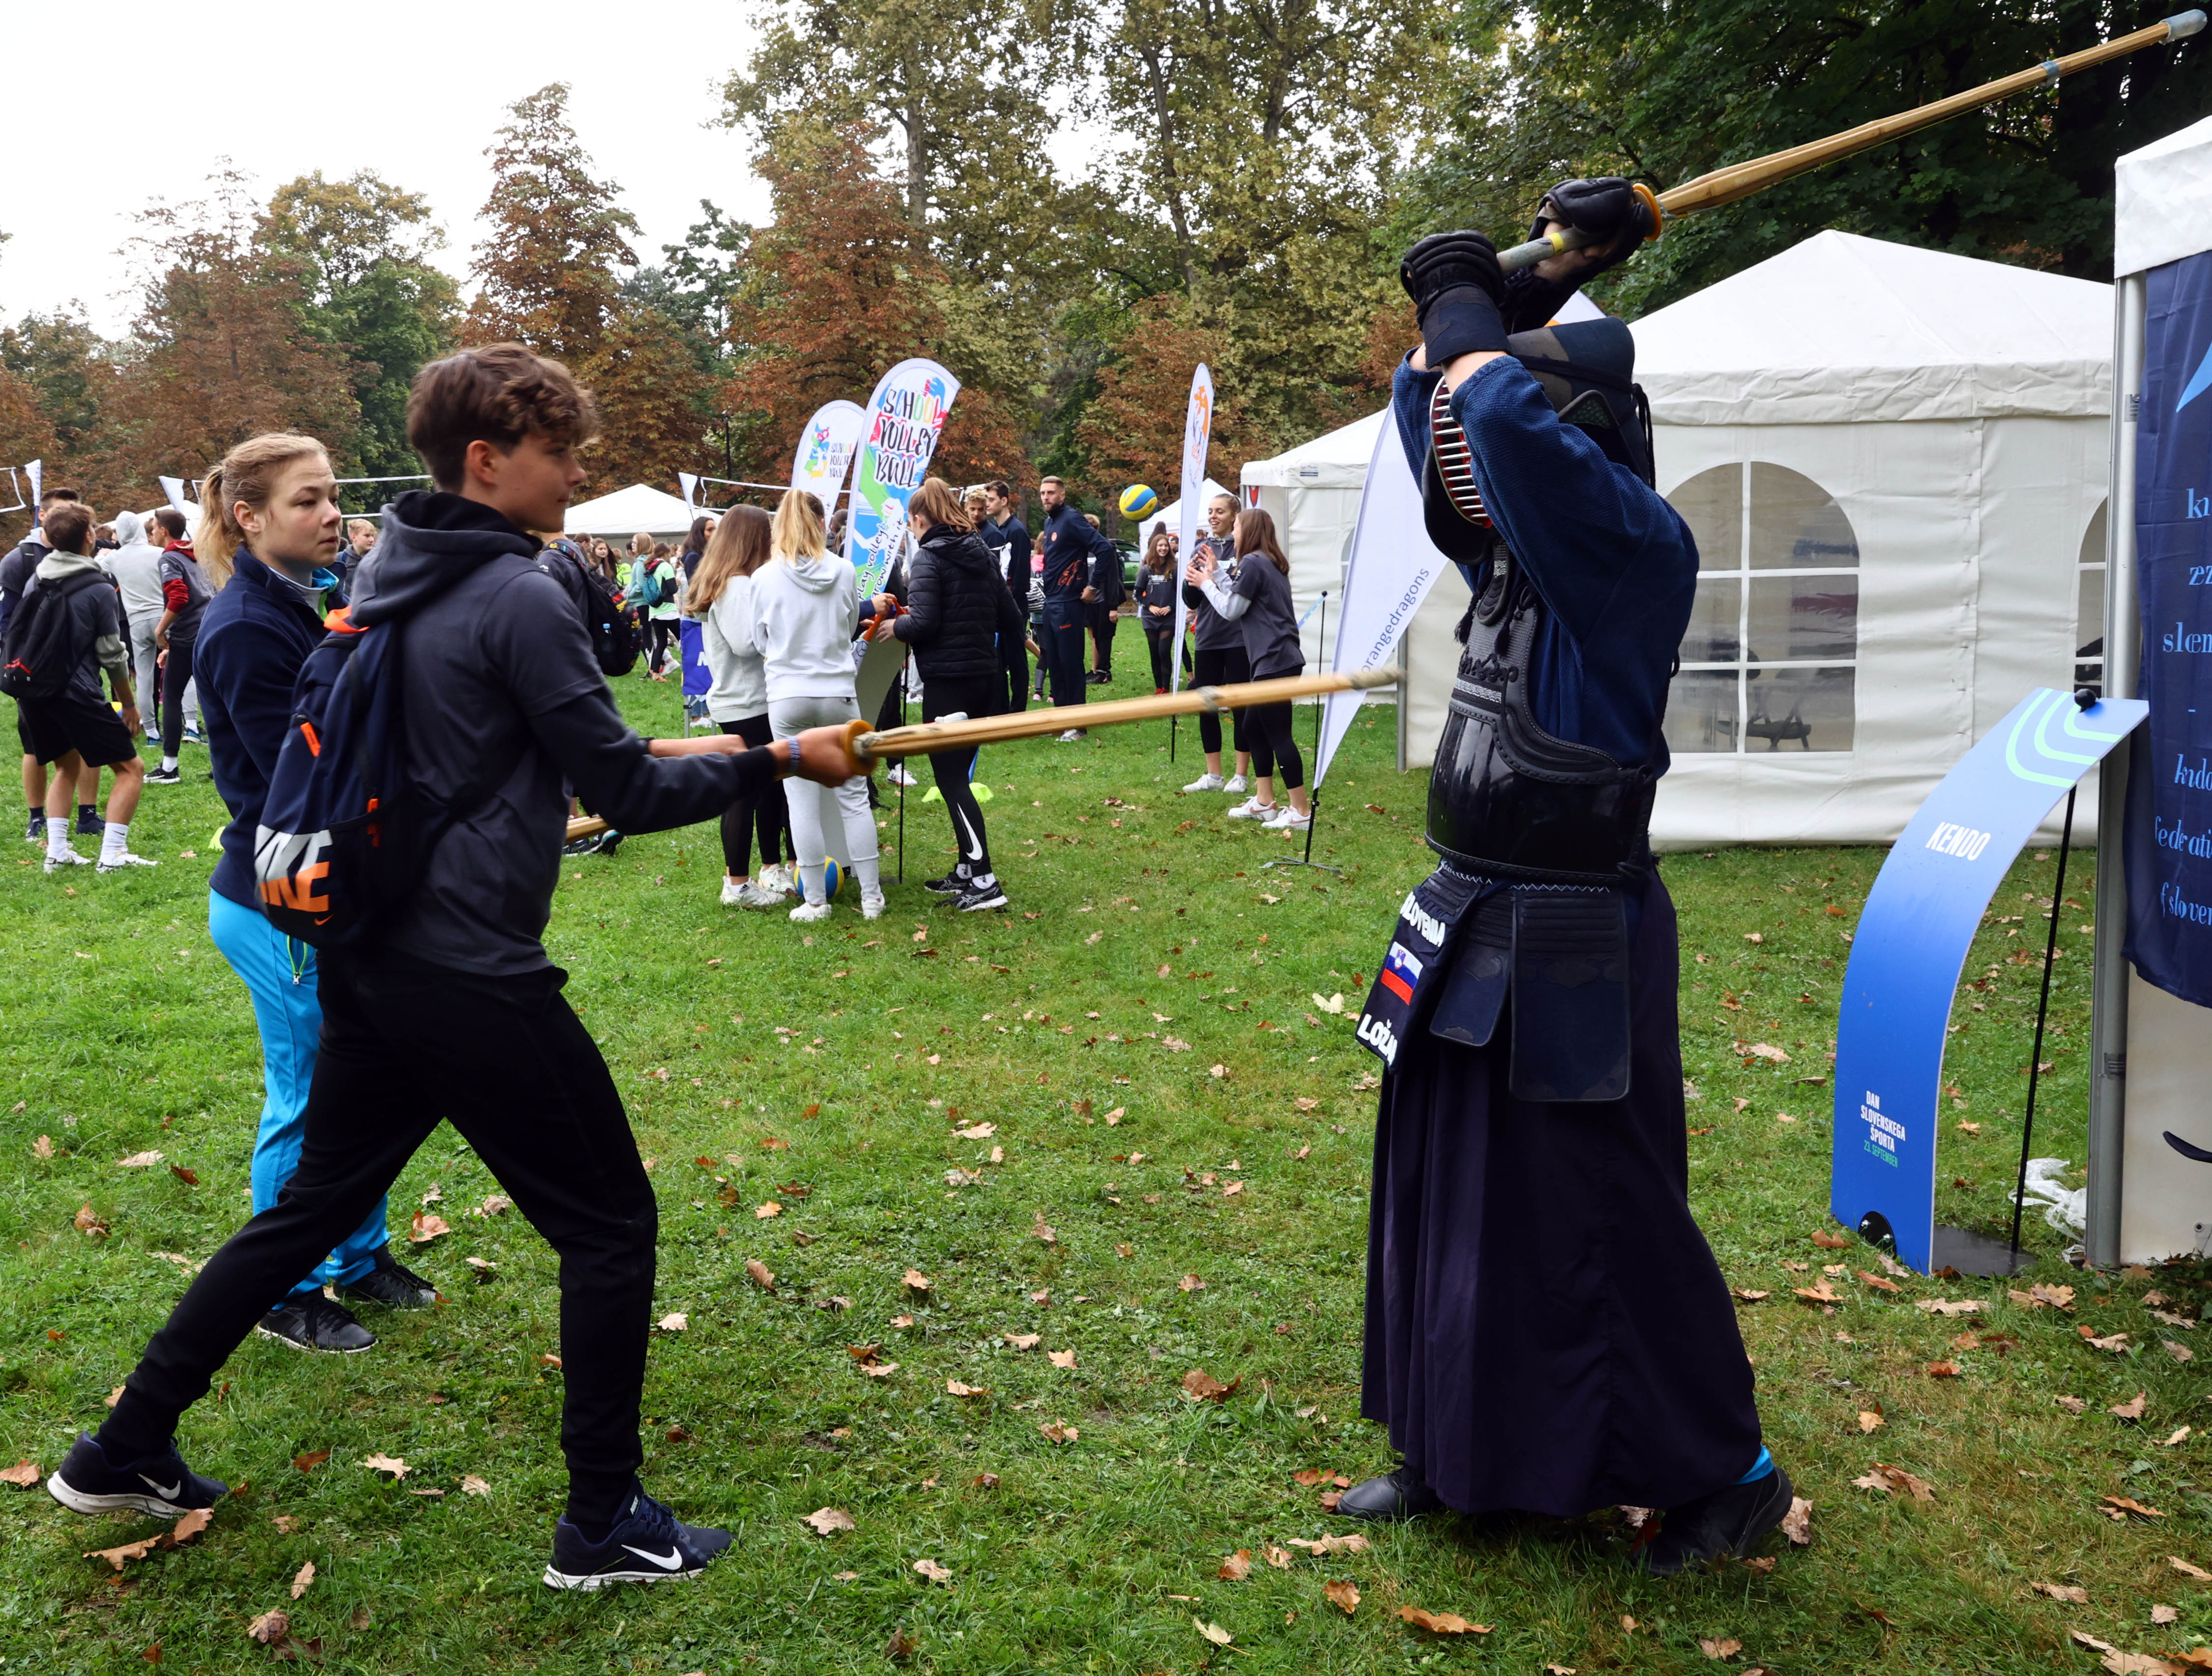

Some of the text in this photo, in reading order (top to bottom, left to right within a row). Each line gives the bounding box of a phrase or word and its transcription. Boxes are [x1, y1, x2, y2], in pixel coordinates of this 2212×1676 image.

[884, 389, 942, 425] SCHOOL
[881, 419, 938, 457] VOLLEY
[876, 454, 918, 487] BALL
[857, 504, 894, 601] play volleyball
[885, 535, 898, 564] with
[893, 518, 903, 530] it
[1925, 821, 1991, 861] KENDO
[1866, 1090, 1880, 1110] DAN
[1861, 1104, 1906, 1142] SLOVENSKEGA
[1870, 1124, 1895, 1153] ŠPORTA
[1872, 1144, 1898, 1168] SEPTEMBER
